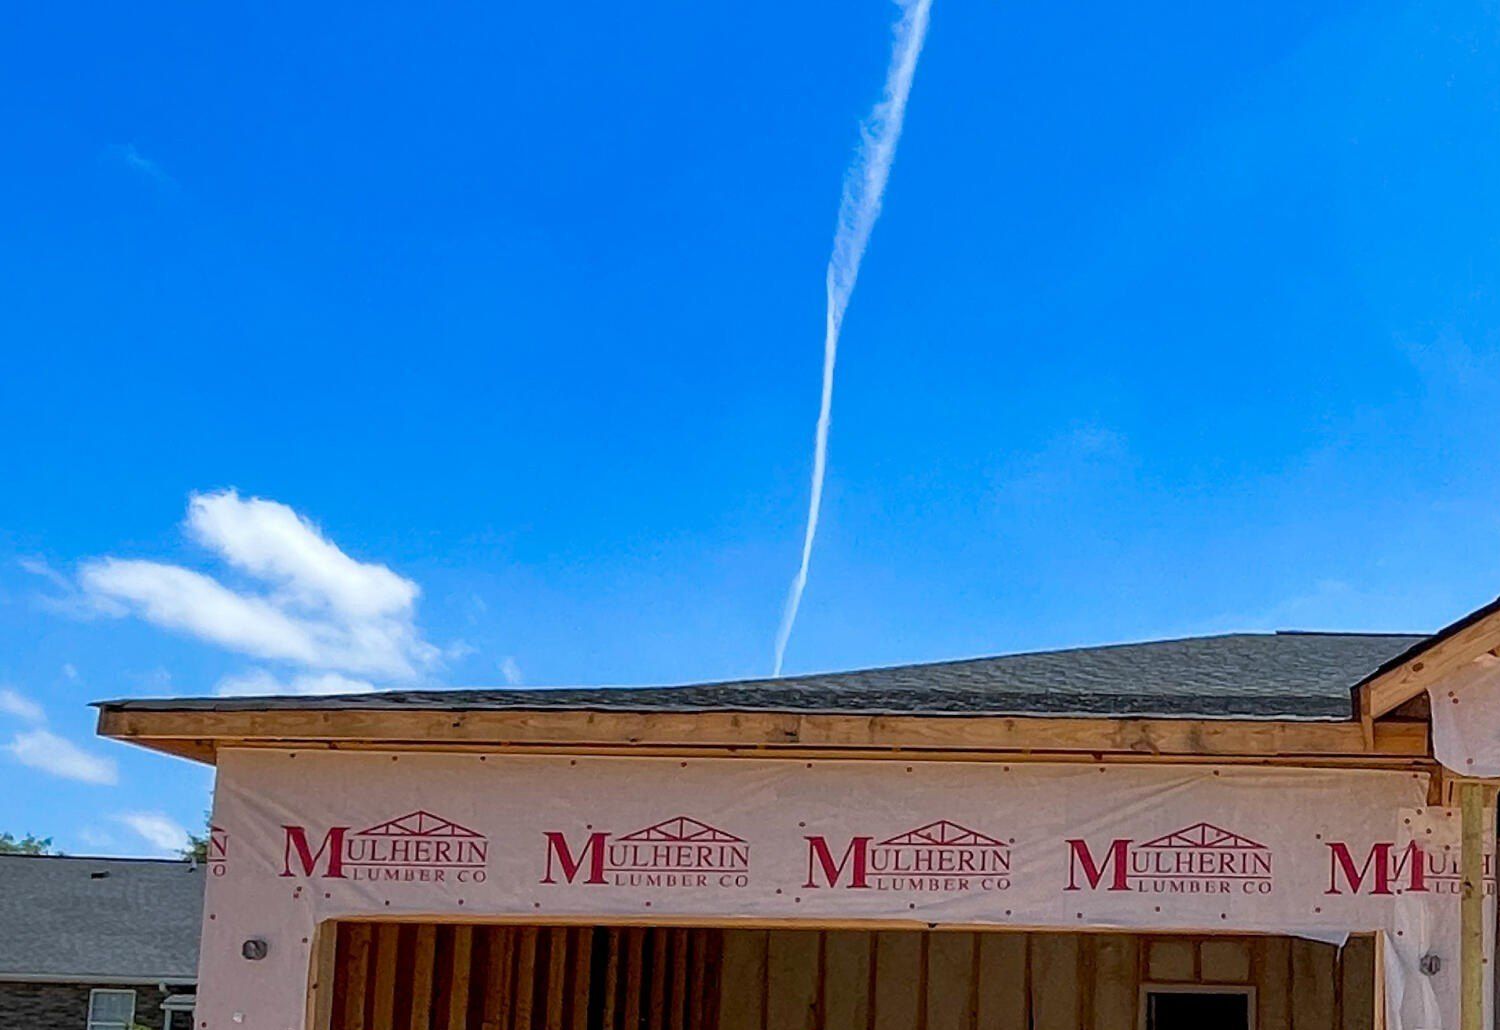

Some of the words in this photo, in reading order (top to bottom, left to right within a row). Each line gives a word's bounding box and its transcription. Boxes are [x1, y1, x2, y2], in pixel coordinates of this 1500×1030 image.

[279, 825, 489, 879] MULHERIN
[540, 831, 750, 886] MULHERIN
[803, 836, 1013, 890] MULHERIN
[1064, 839, 1273, 892] MULHERIN
[352, 868, 446, 883] LUMBER
[457, 868, 487, 883] CO
[614, 873, 708, 888] LUMBER
[720, 873, 749, 888] CO
[876, 878, 970, 892] LUMBER
[981, 877, 1011, 891] CO
[1138, 880, 1233, 895] LUMBER
[1243, 880, 1273, 895] CO
